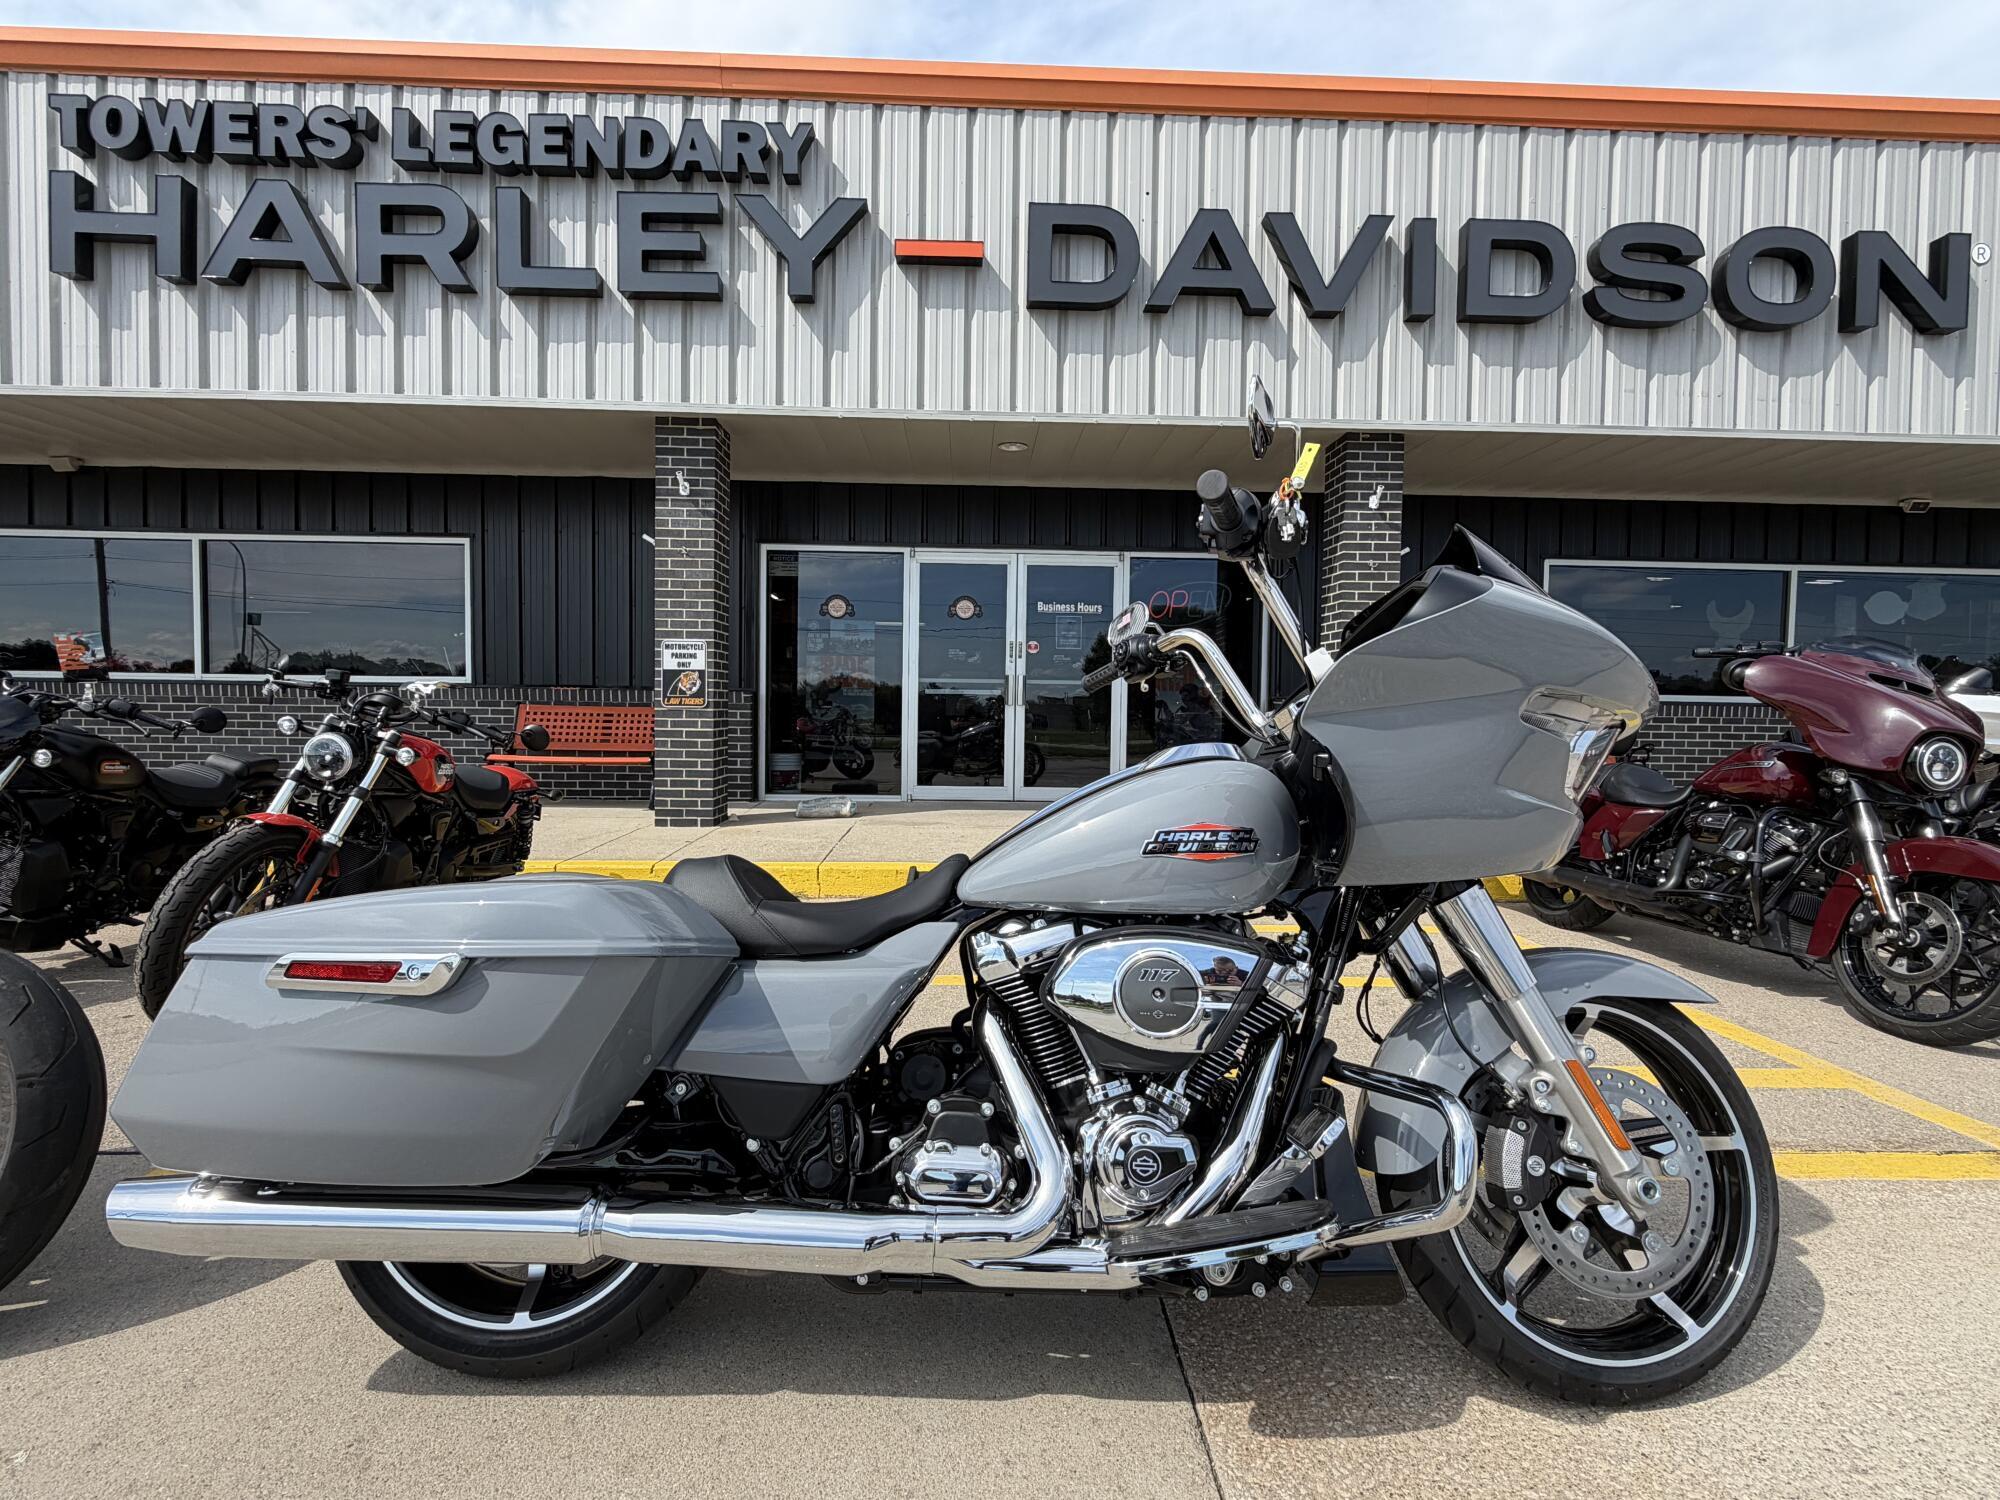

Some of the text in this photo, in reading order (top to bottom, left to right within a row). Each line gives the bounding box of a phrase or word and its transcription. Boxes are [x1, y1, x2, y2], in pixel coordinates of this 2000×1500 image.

[48, 93, 816, 186] TOWERS' LEGENDARY
[1026, 202, 1972, 336] DAVIDSON
[1037, 601, 1103, 614] Business Hours
[1148, 589, 1226, 619] OPEN
[664, 643, 704, 651] MOTORCYCLE
[671, 652, 698, 660] PARKING
[676, 661, 692, 669] ONLY
[664, 697, 704, 705] LAW TIGERS
[1145, 841, 1256, 853] DAVIDSON
[1138, 968, 1180, 983] 117
